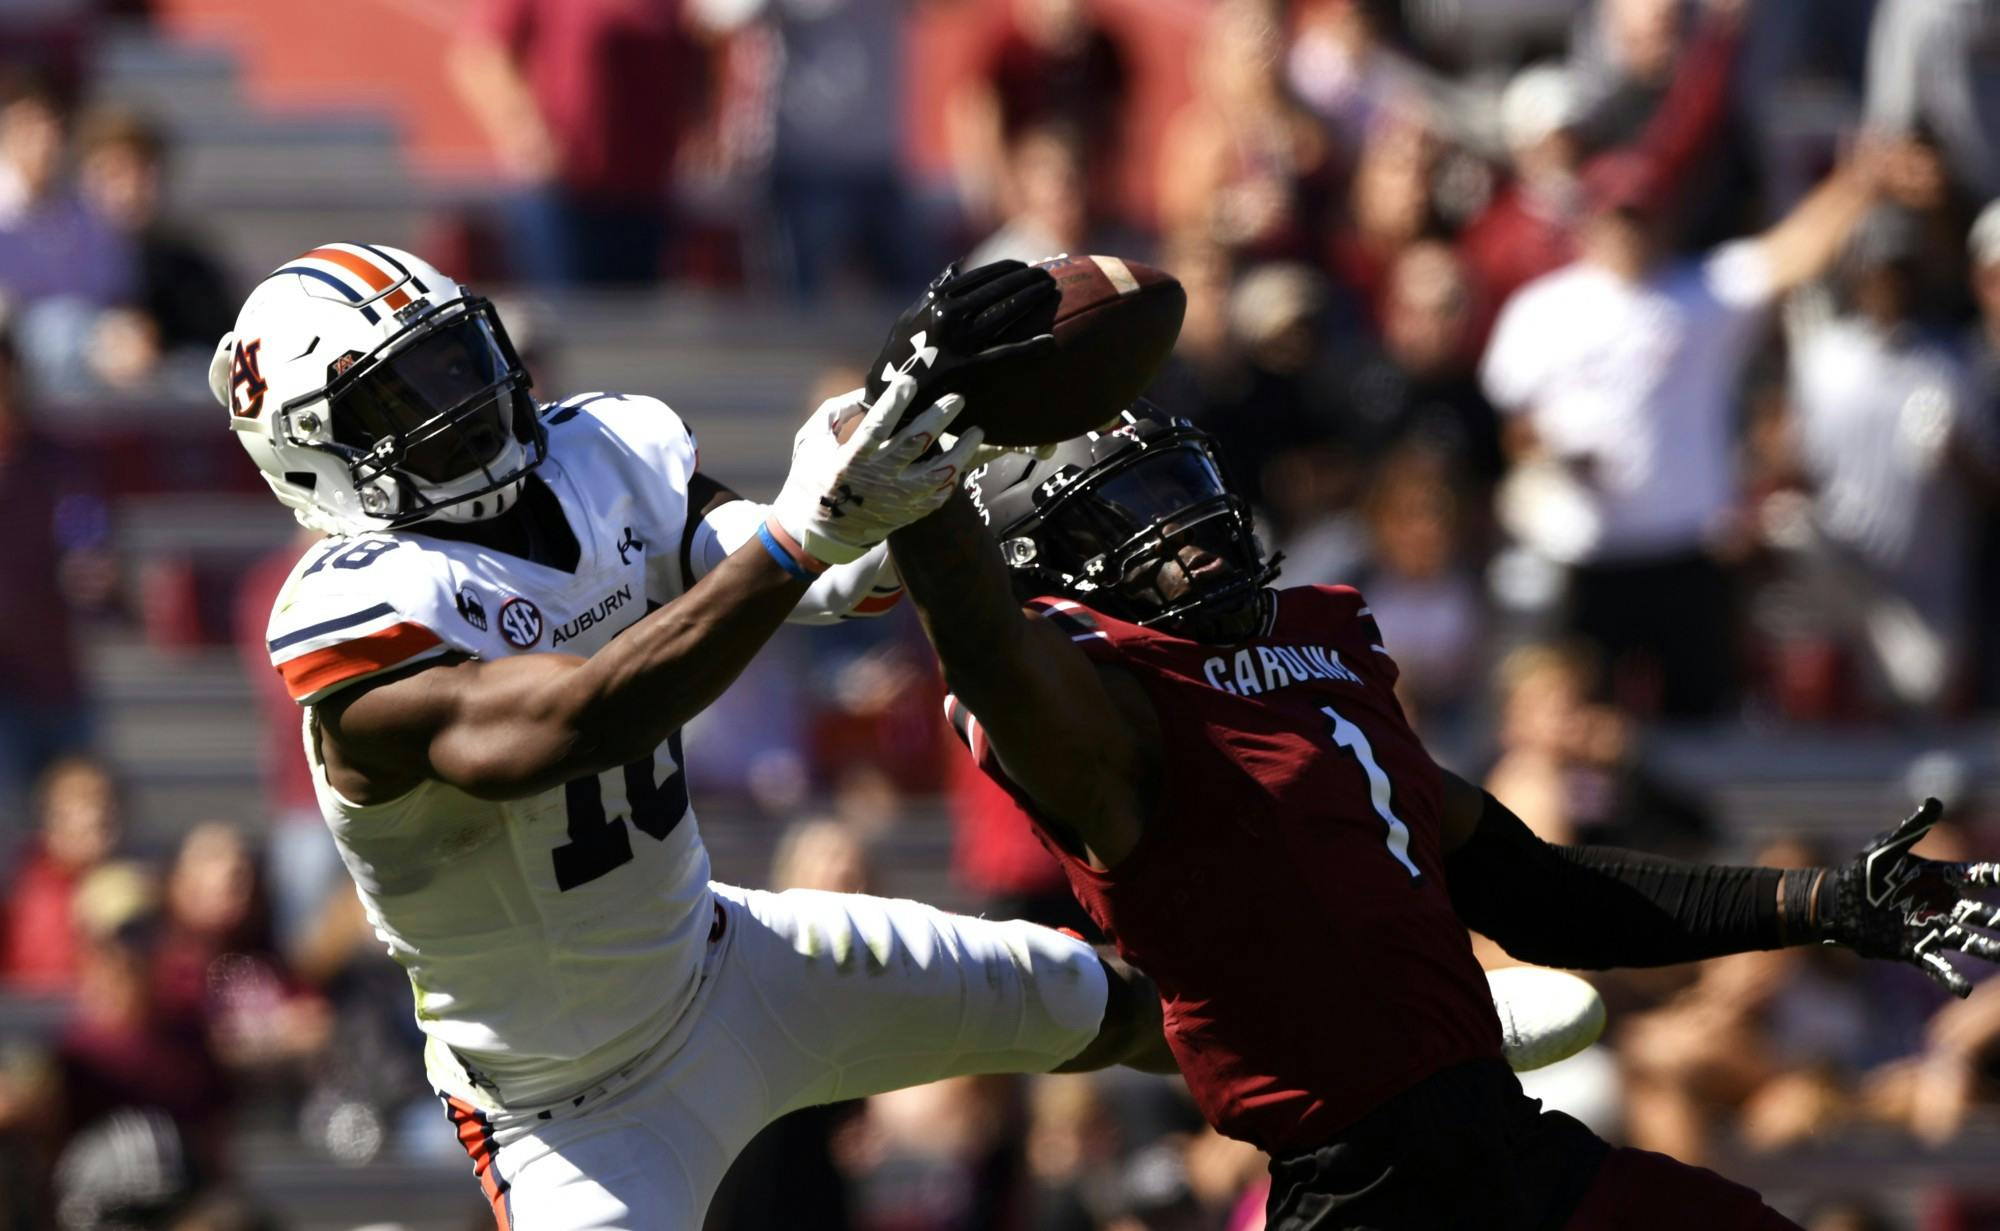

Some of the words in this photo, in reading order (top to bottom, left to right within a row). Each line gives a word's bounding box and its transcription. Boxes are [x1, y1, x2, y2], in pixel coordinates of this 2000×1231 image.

[302, 540, 400, 579] 18
[502, 602, 540, 646] SEC
[552, 584, 632, 648] AUBURN
[1203, 646, 1365, 696] CAROLINA
[1320, 706, 1421, 878] 1
